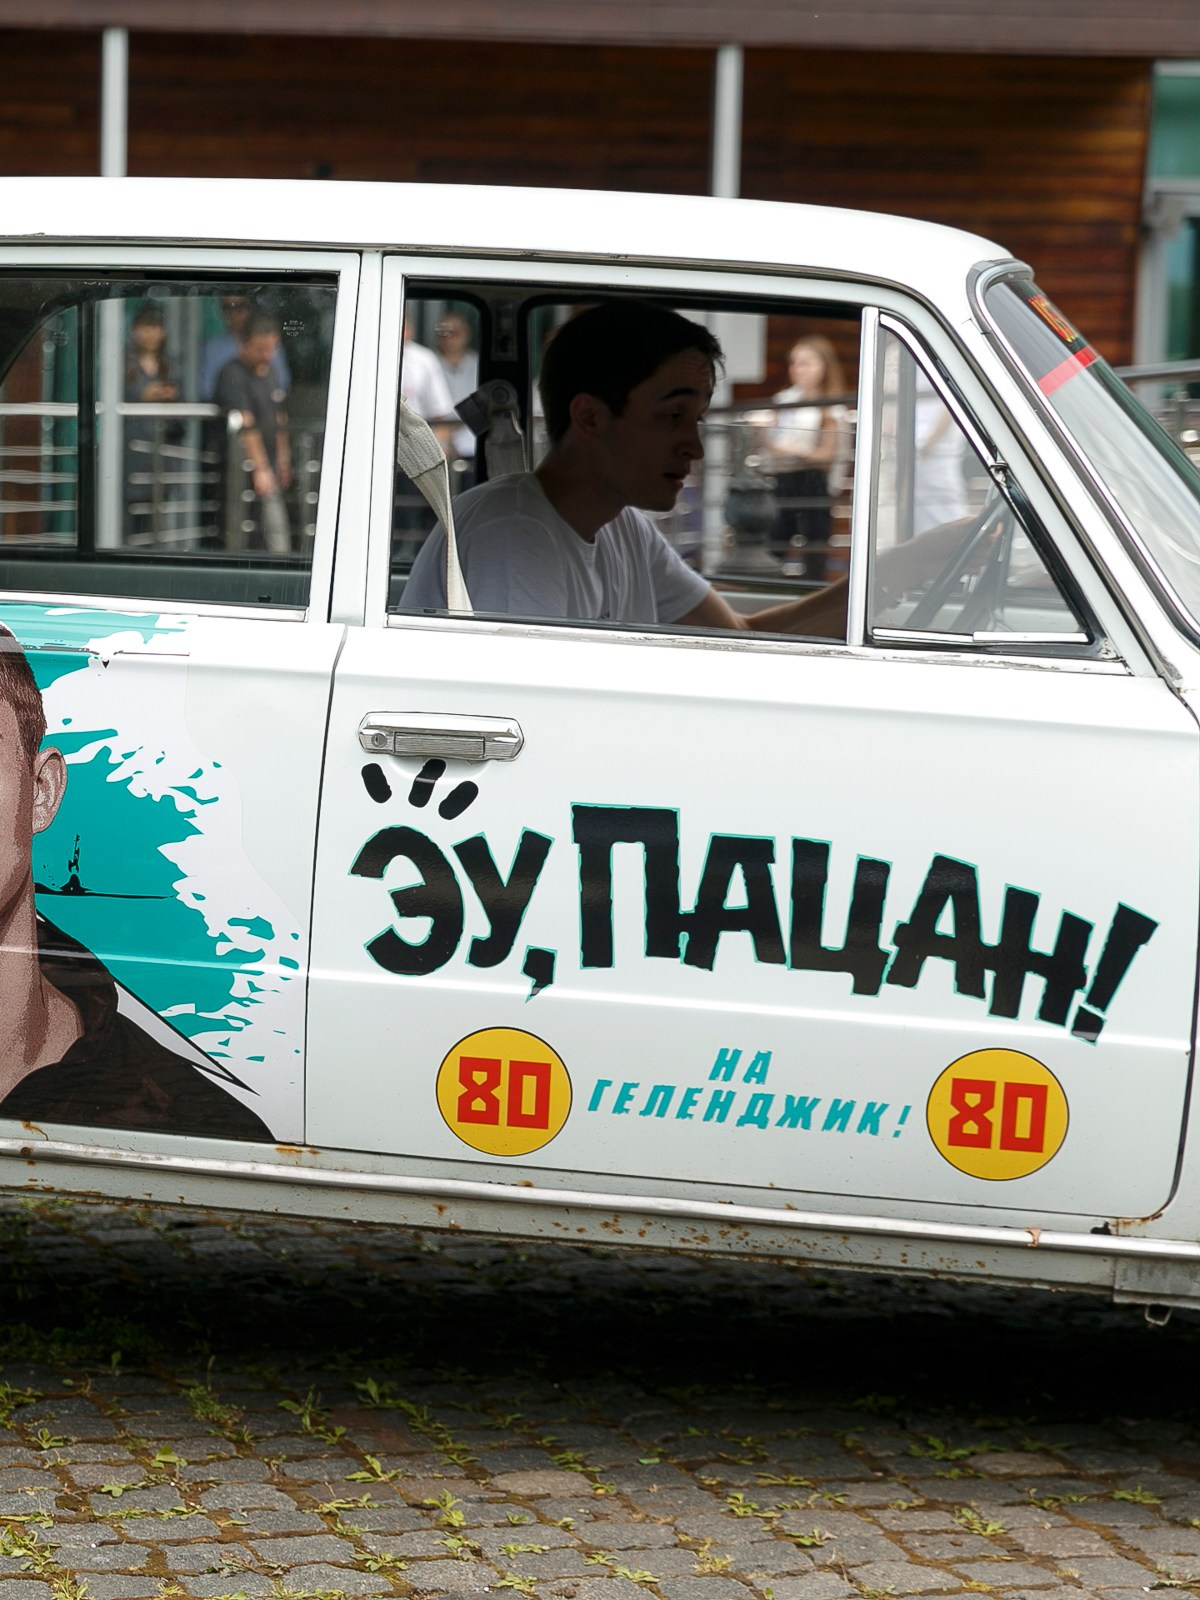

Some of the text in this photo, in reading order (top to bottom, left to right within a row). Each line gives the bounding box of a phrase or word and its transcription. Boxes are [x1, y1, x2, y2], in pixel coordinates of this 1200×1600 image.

[348, 802, 1160, 1044] ЭУ, ПАЦАН!
[456, 1056, 552, 1129] 80
[707, 1047, 772, 1085] НА
[587, 1078, 912, 1138] ГЕЛЕНДЖИК!
[947, 1078, 1049, 1153] 80
